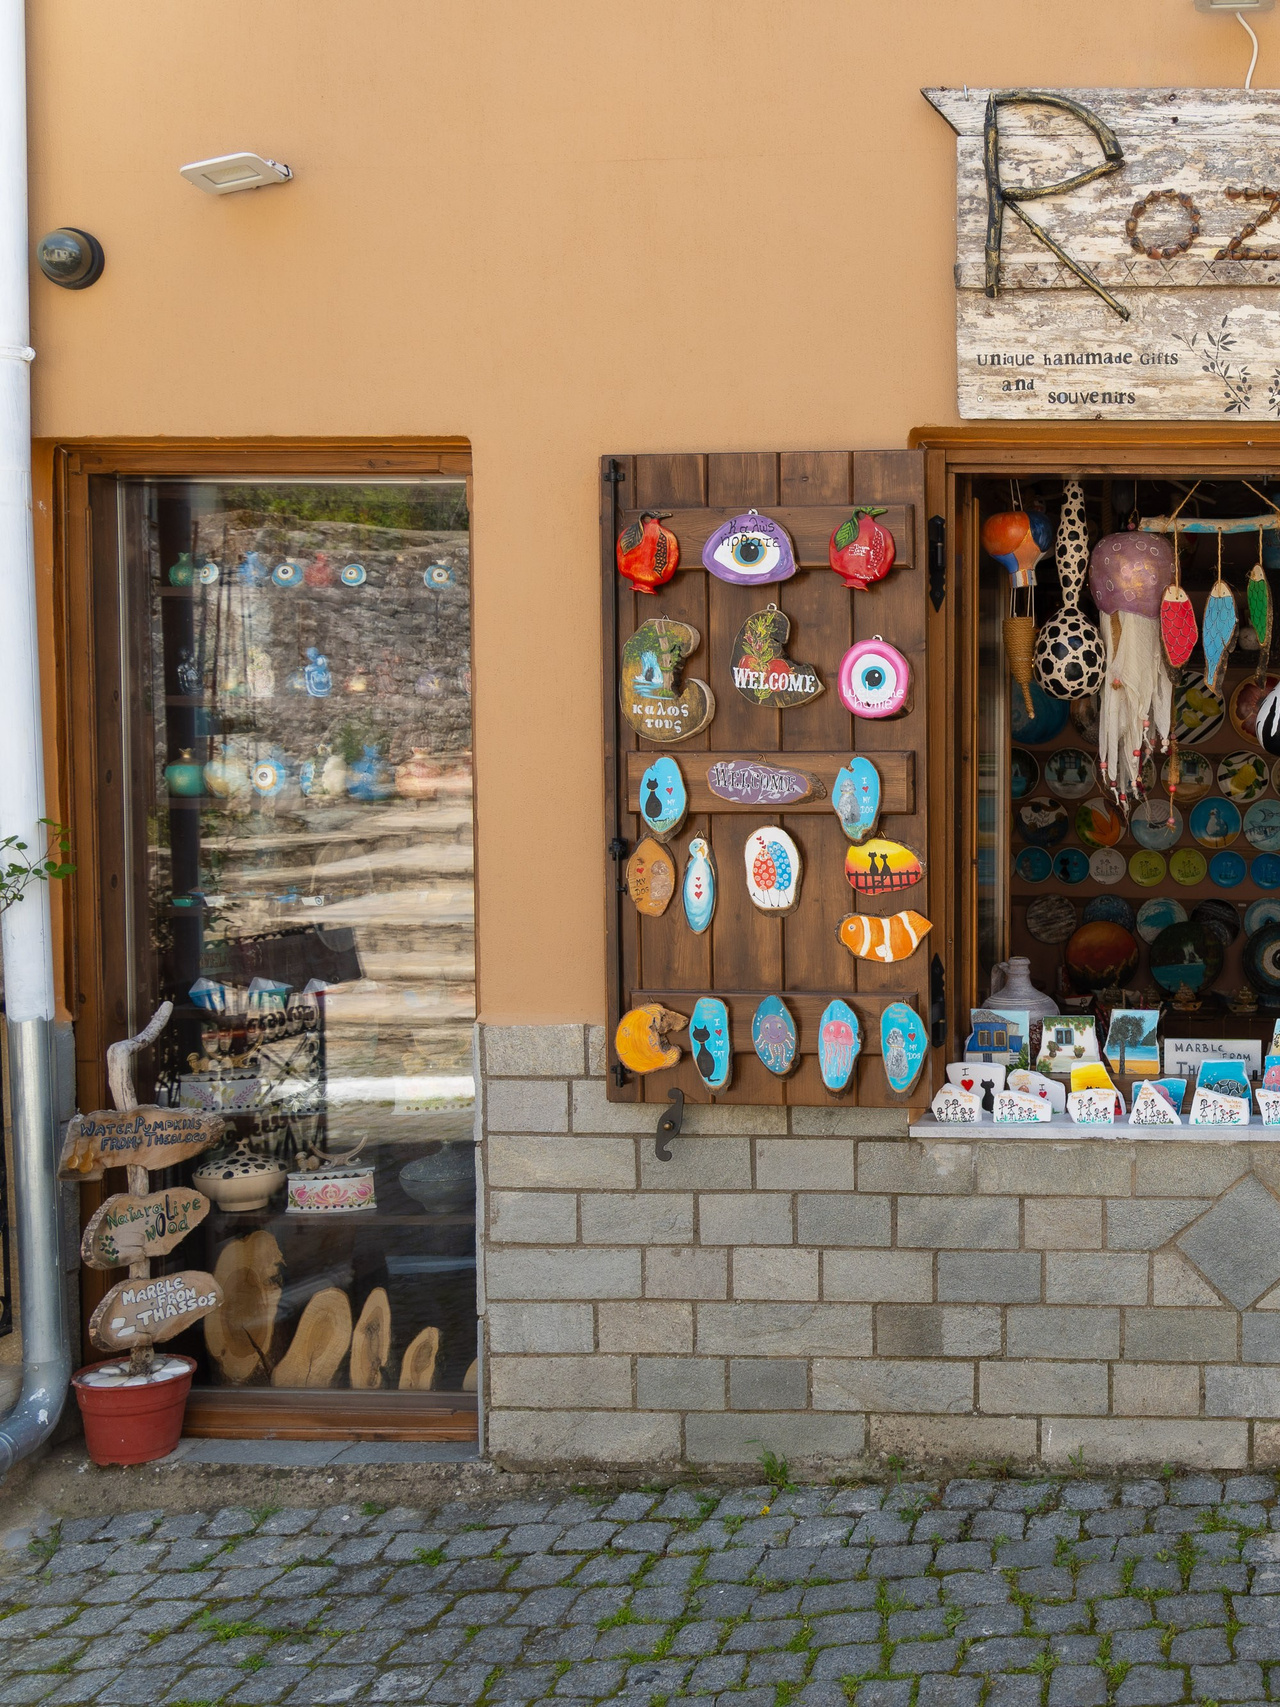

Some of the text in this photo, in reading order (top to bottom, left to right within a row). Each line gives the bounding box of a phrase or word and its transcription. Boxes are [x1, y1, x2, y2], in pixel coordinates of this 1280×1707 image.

[1044, 350, 1132, 366] handmade
[1140, 352, 1179, 366] Gifts
[1002, 377, 1034, 392] and
[1048, 390, 1136, 404] souvenirs
[732, 667, 815, 693] WELCOME
[854, 697, 894, 711] home
[714, 767, 797, 793] WELCOME
[860, 806, 874, 814] DOG
[962, 1067, 970, 1077] I
[101, 1136, 138, 1150] FROM
[121, 1276, 185, 1306] MARBLE
[157, 1287, 196, 1308] FROM
[136, 1291, 217, 1326] THASSOS
